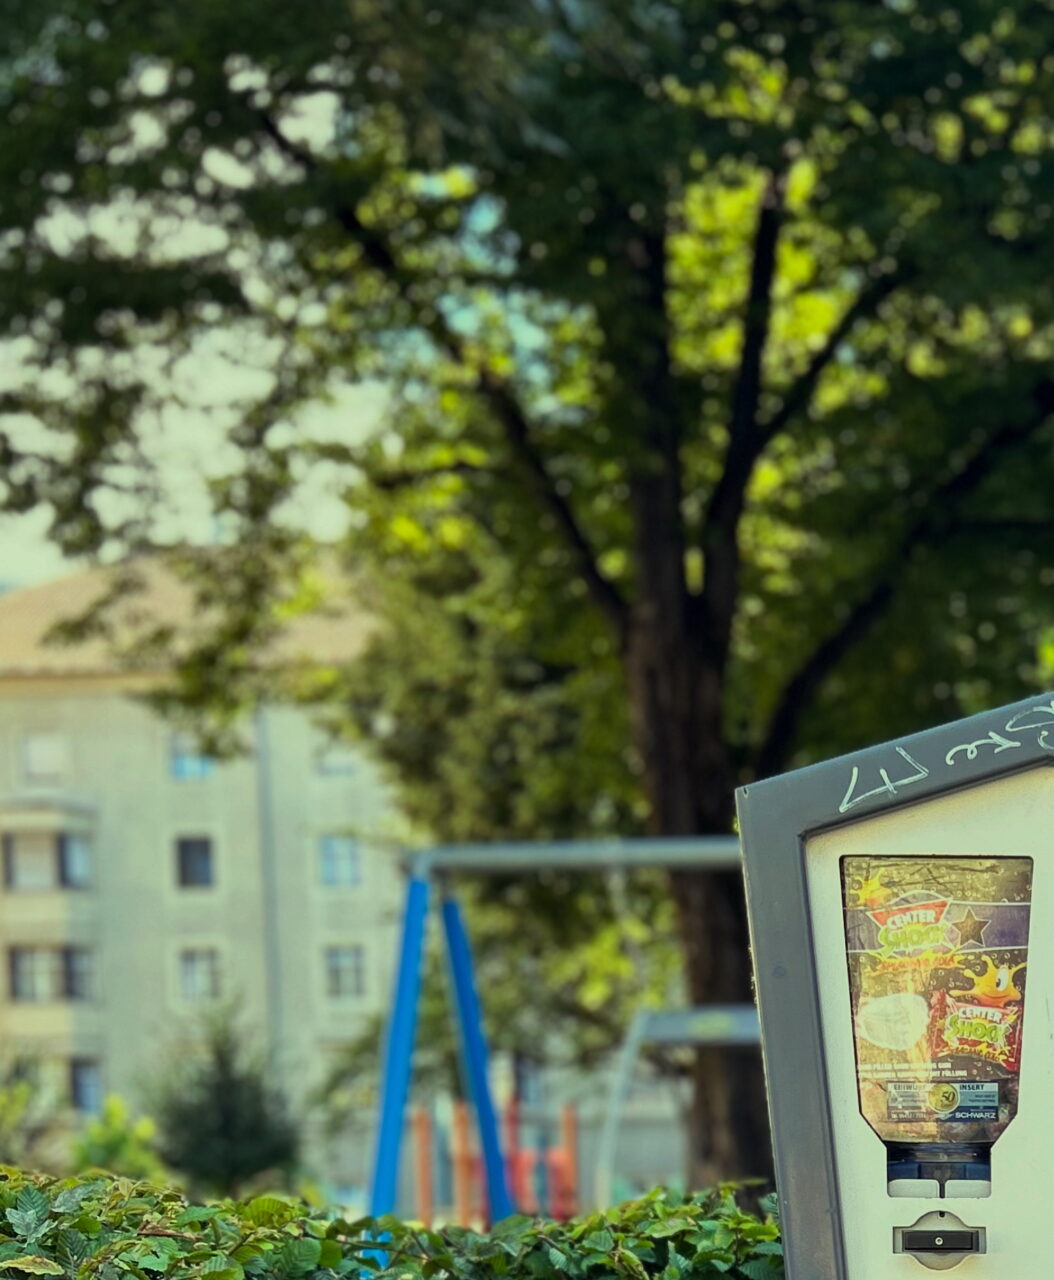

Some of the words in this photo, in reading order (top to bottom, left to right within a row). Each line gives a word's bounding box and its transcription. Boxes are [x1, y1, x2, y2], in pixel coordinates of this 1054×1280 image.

[886, 908, 935, 930] CENTER
[878, 922, 948, 958] SHOCK
[959, 1006, 1002, 1022] CENTER
[945, 1015, 1012, 1047] SHOCK
